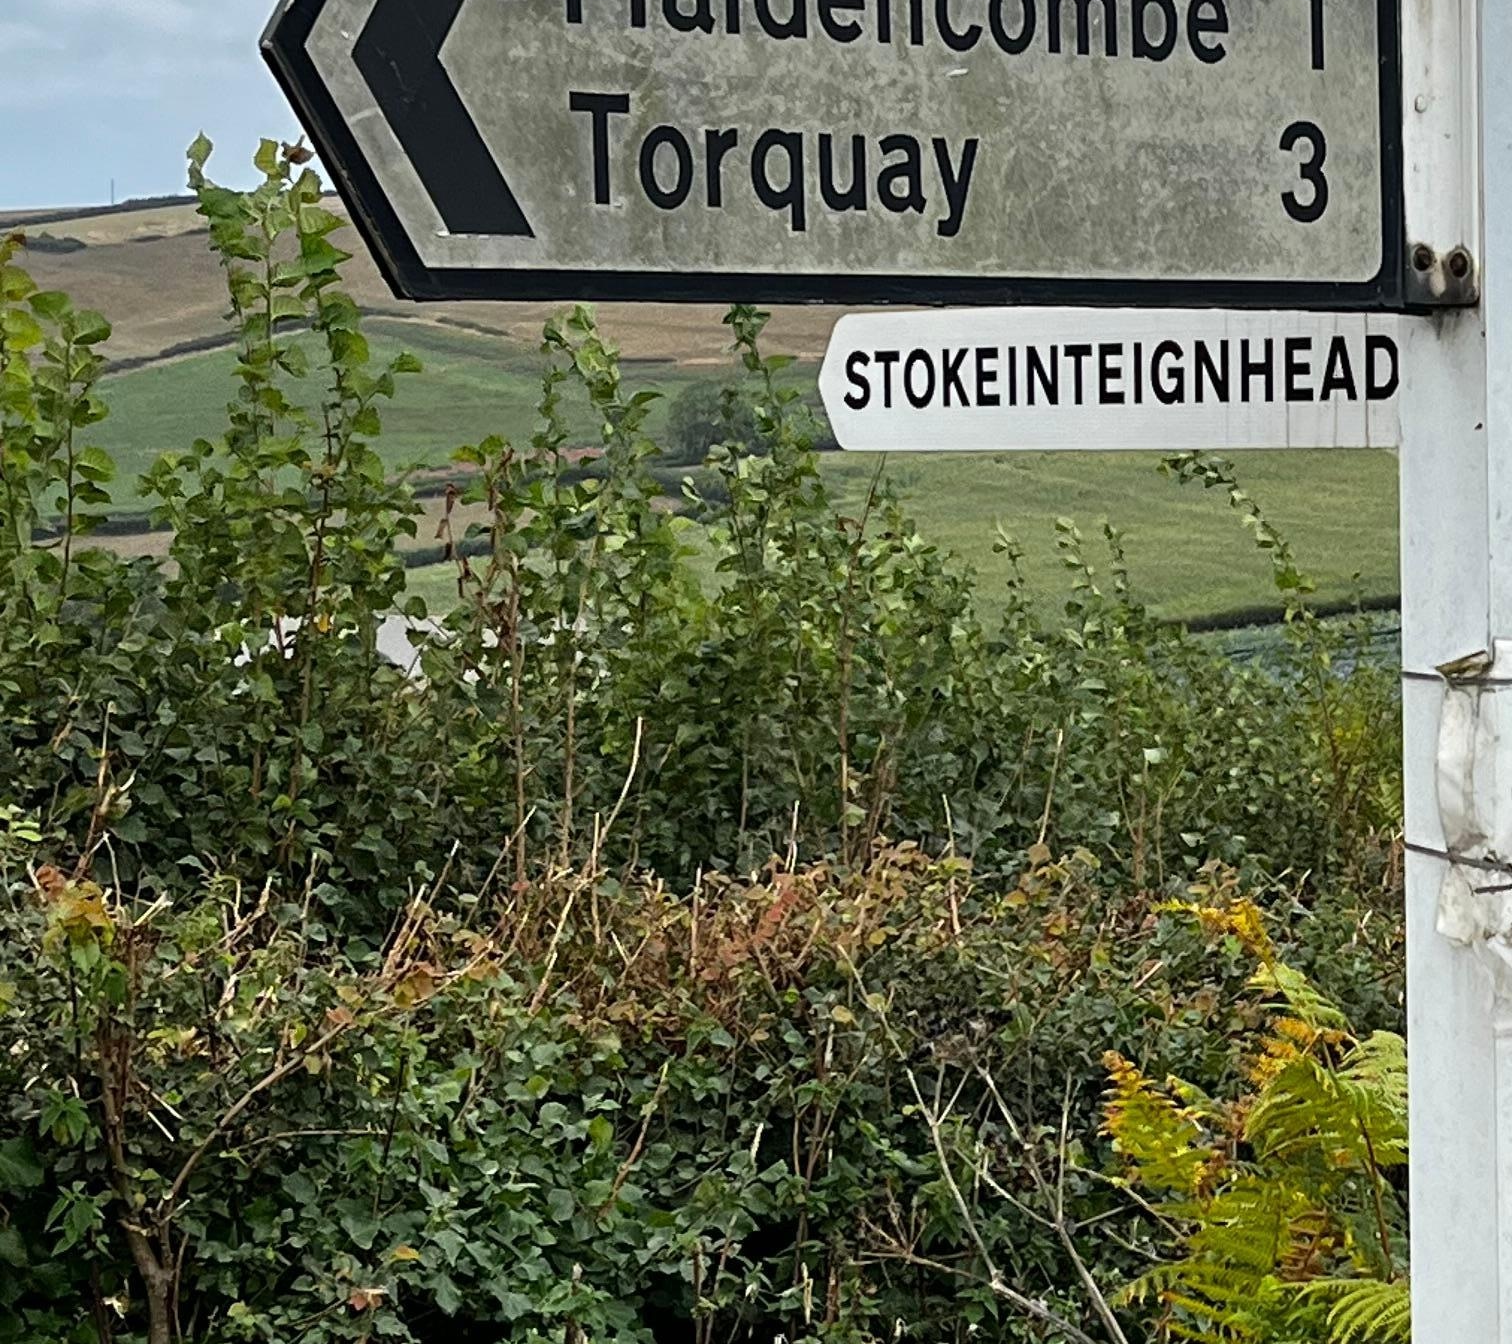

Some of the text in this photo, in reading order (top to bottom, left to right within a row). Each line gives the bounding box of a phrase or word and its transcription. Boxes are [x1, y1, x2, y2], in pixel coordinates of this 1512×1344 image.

[569, 91, 1329, 237] Torquay 3
[843, 334, 1400, 410] STOKEINTEIGNHEAD
